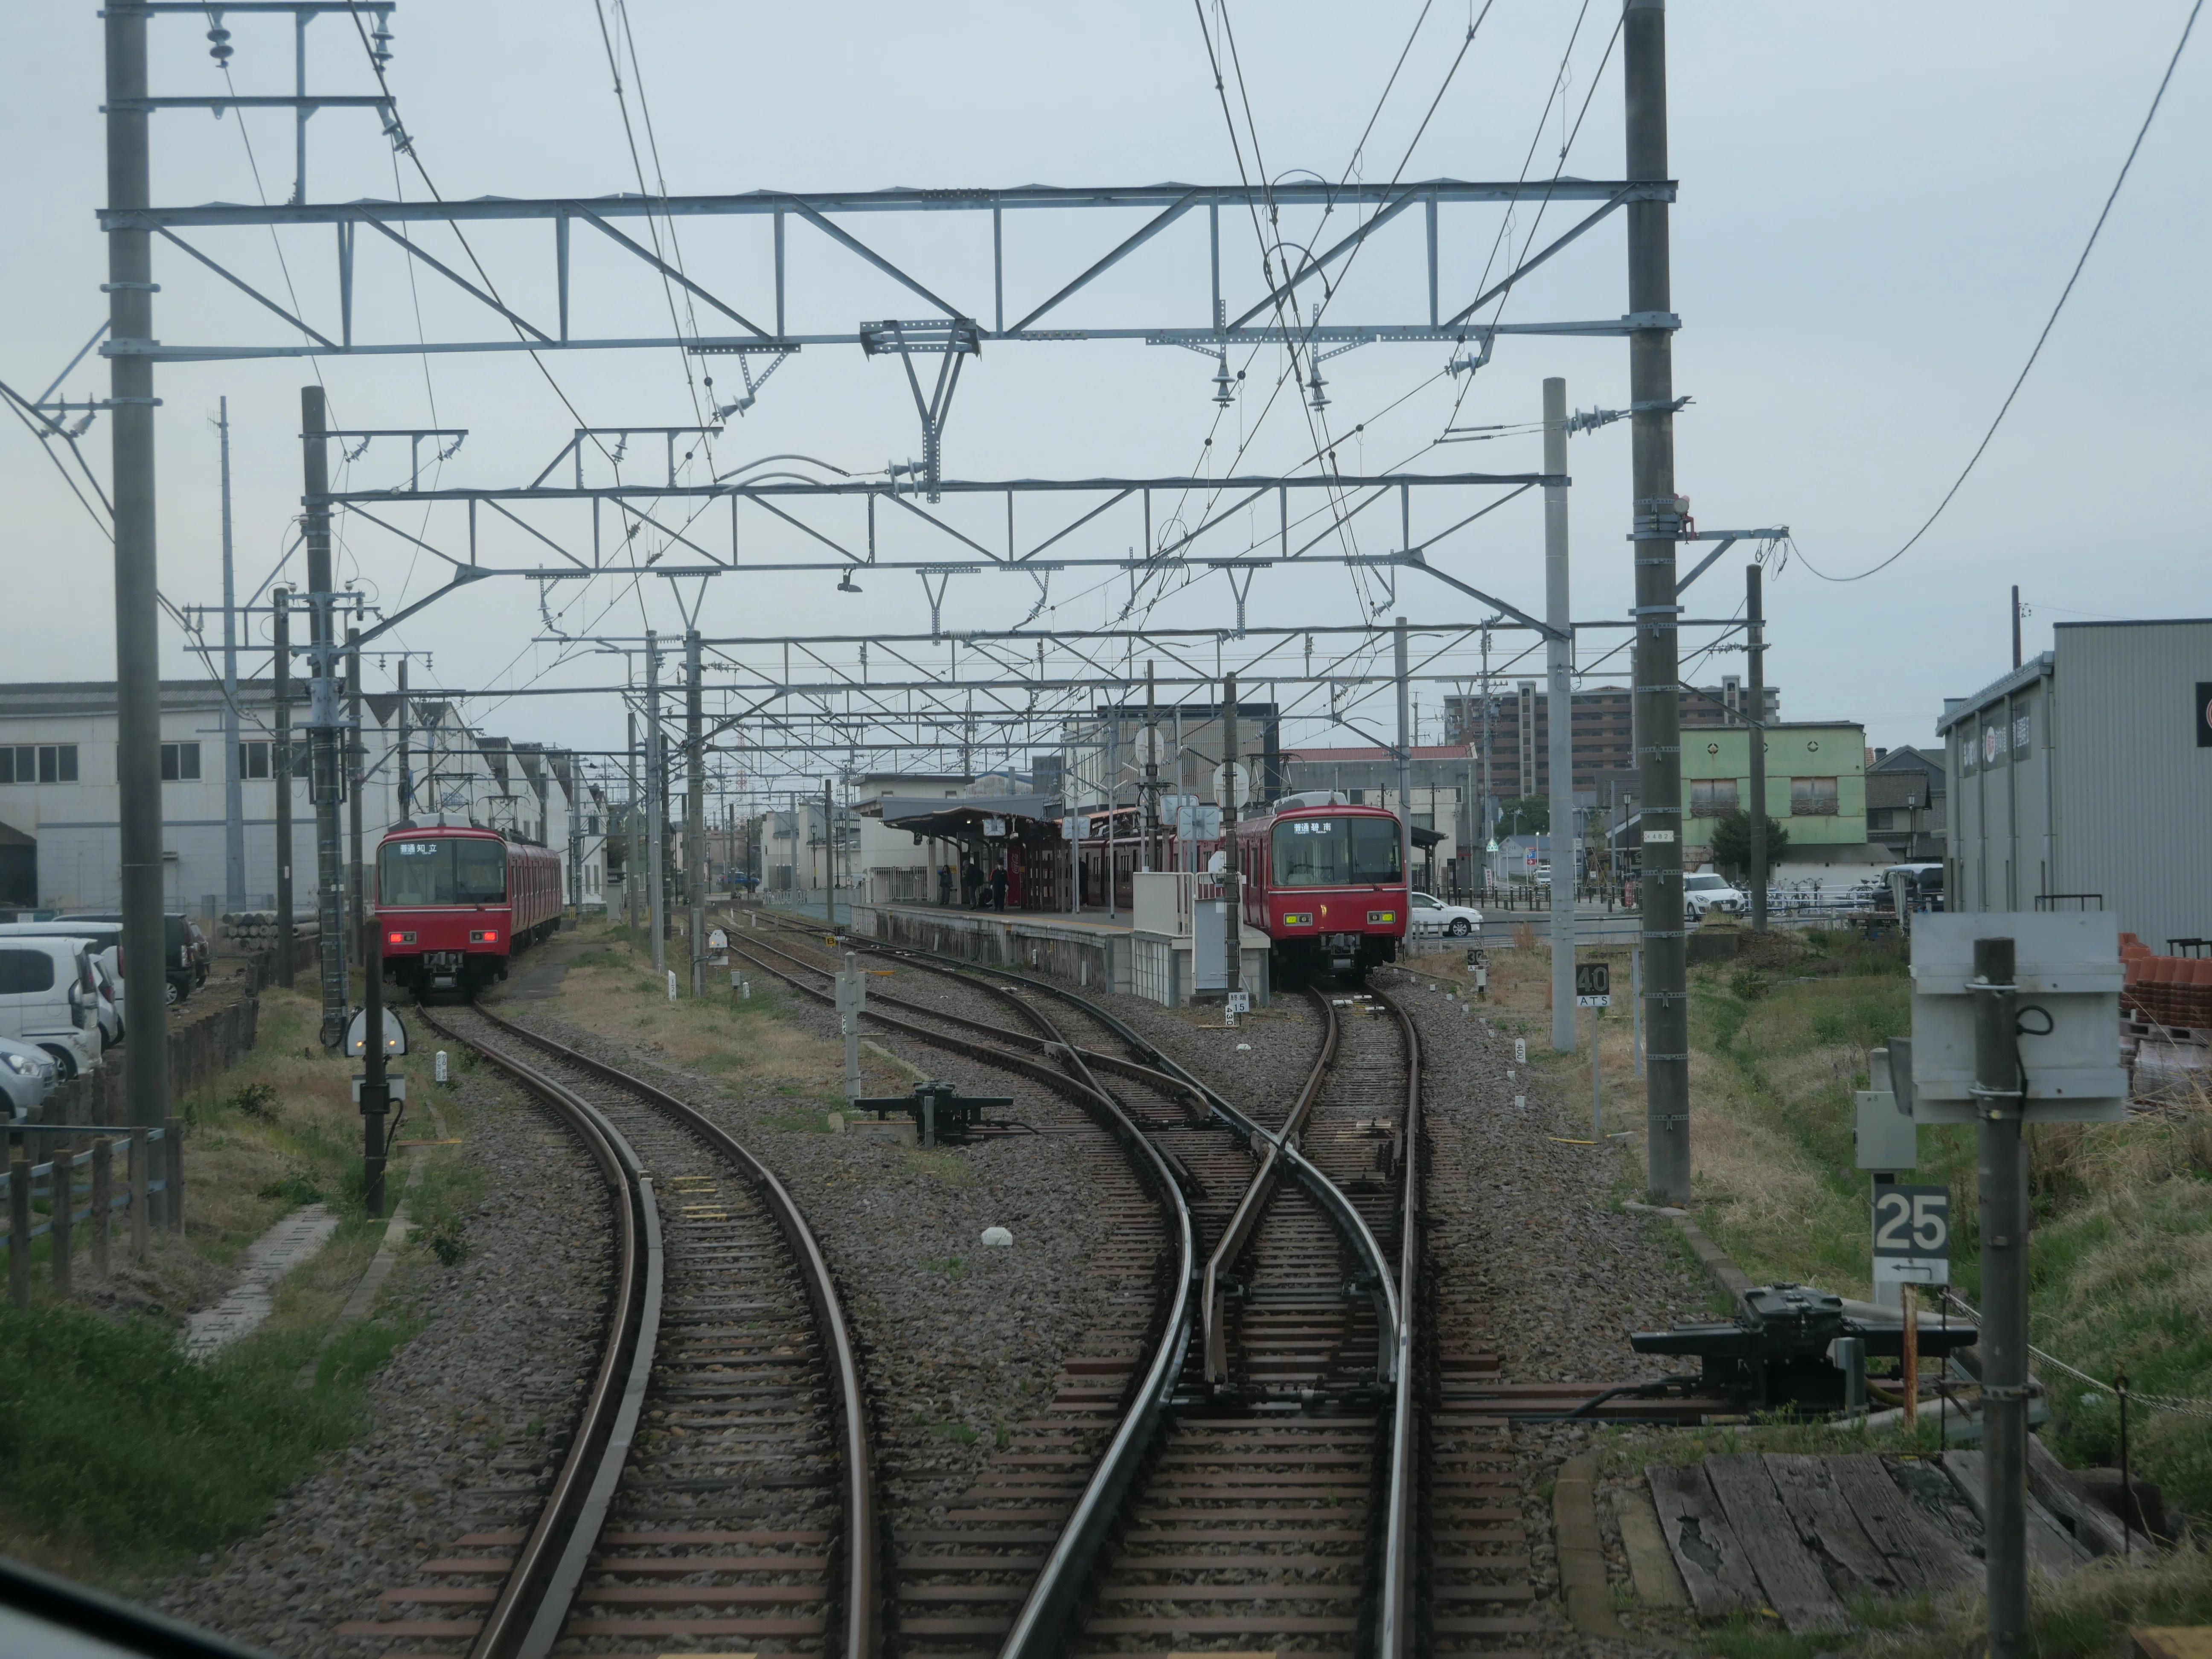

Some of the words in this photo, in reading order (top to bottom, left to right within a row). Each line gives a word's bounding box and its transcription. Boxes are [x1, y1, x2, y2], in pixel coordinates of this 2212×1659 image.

[1294, 823, 1309, 832] 普通
[1311, 823, 1331, 831] 碧南
[400, 844, 415, 852] 普通
[417, 844, 437, 852] 知立
[1577, 967, 1608, 992] 40
[1580, 996, 1607, 1005] ATS
[1877, 1193, 1946, 1249] 25
